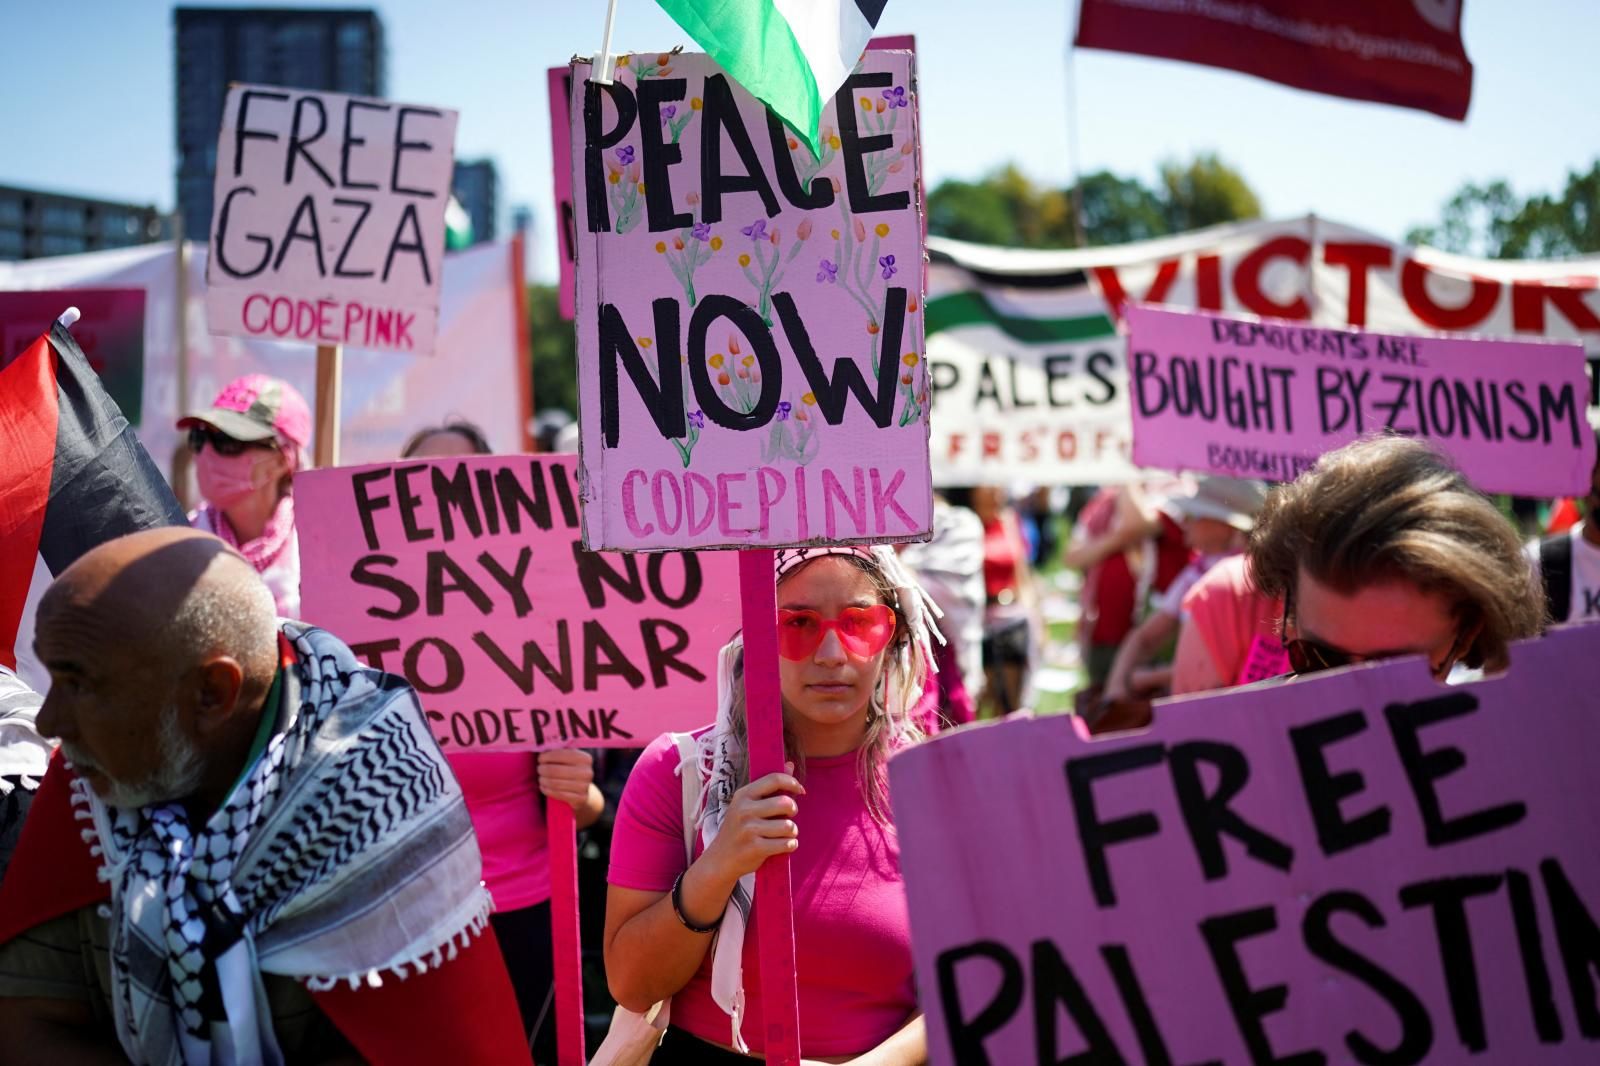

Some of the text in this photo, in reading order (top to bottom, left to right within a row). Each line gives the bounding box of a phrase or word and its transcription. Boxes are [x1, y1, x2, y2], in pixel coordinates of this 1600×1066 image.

[234, 90, 443, 197] FREE
[584, 72, 911, 233] PEACE
[216, 187, 431, 285] GAZA
[242, 294, 415, 350] CODEPINK
[1091, 235, 1600, 330] VICTOR
[599, 287, 907, 449] NOW
[931, 352, 1117, 410] PALES
[1212, 319, 1428, 367] DEMOCRATS ARE
[1134, 352, 1582, 448] BOUGHT BY ZIONISM
[352, 461, 579, 550] FEMINI
[621, 466, 919, 539] CODEPINK
[350, 540, 703, 621] SAY NO
[350, 618, 707, 696] TO WAR
[425, 708, 633, 747] CODEPINK
[1065, 693, 1528, 908] FREE
